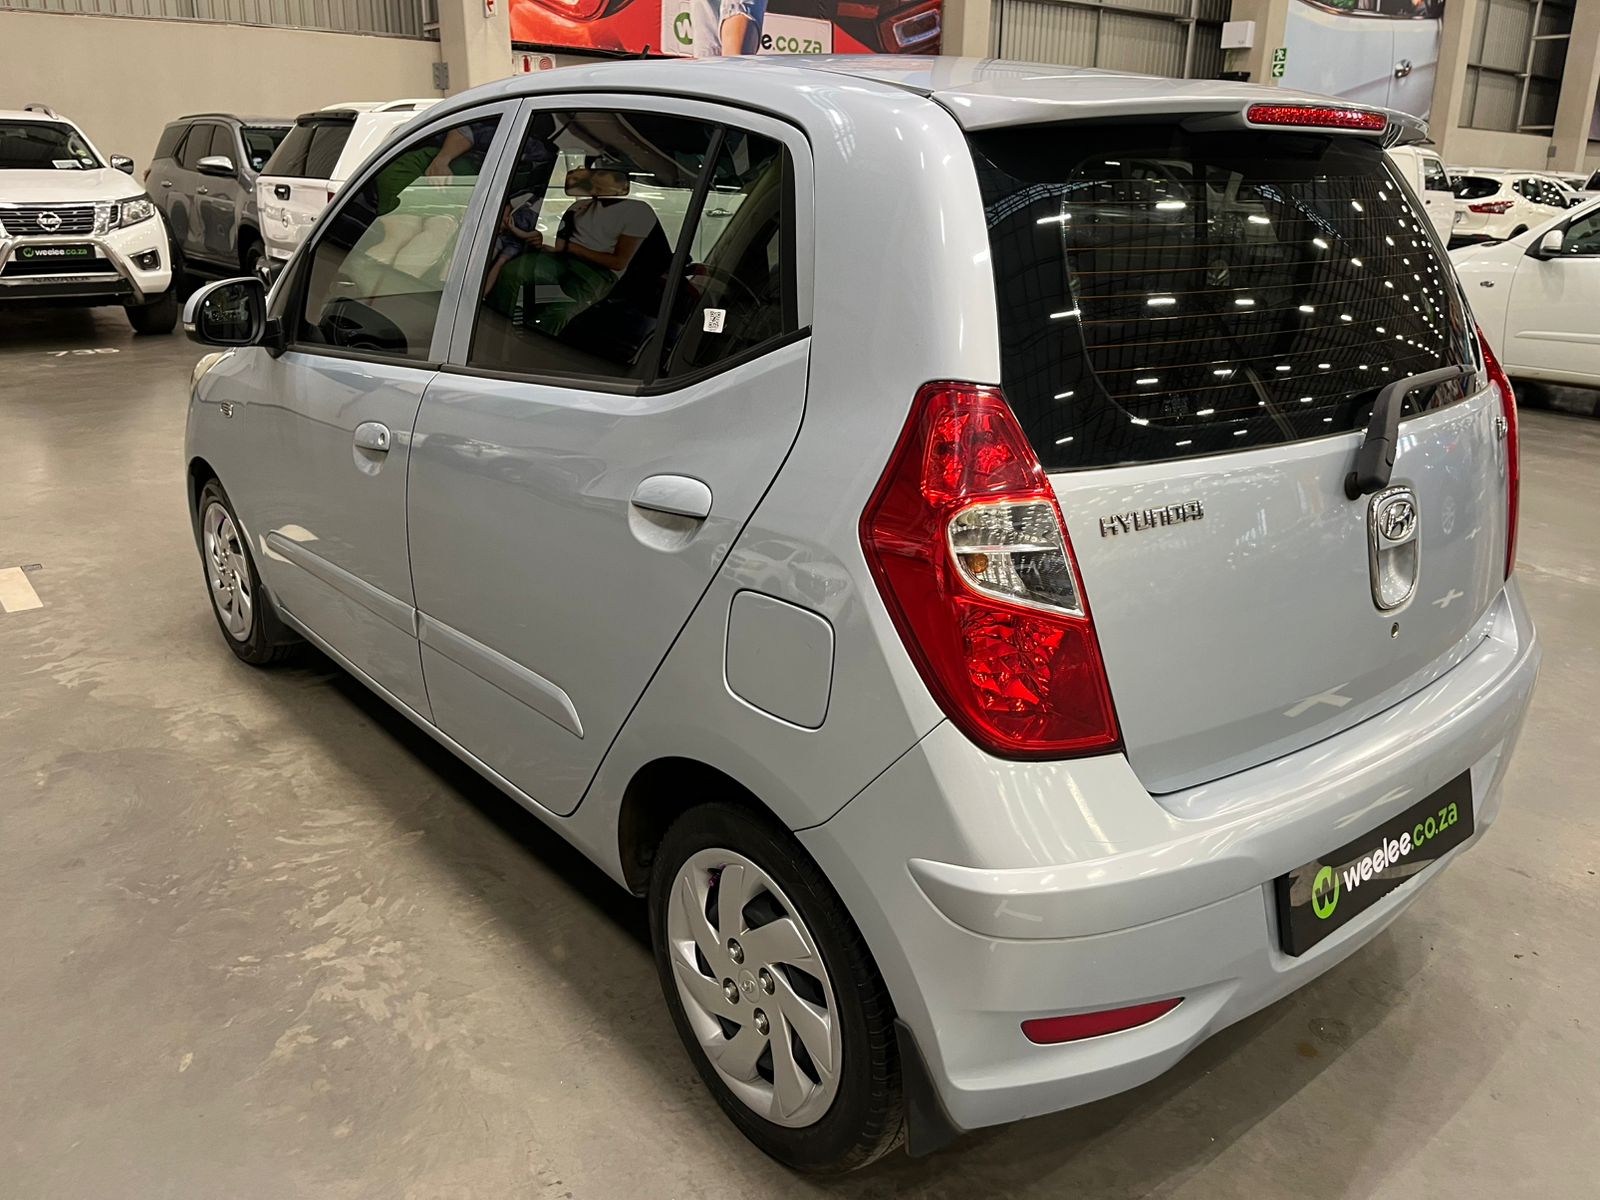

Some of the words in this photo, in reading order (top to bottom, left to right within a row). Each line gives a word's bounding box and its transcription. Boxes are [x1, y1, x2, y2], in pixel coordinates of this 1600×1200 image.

[761, 34, 823, 54] e.co.za
[1099, 500, 1204, 538] HYUNDAI
[1343, 802, 1458, 892] weelee.co.za
